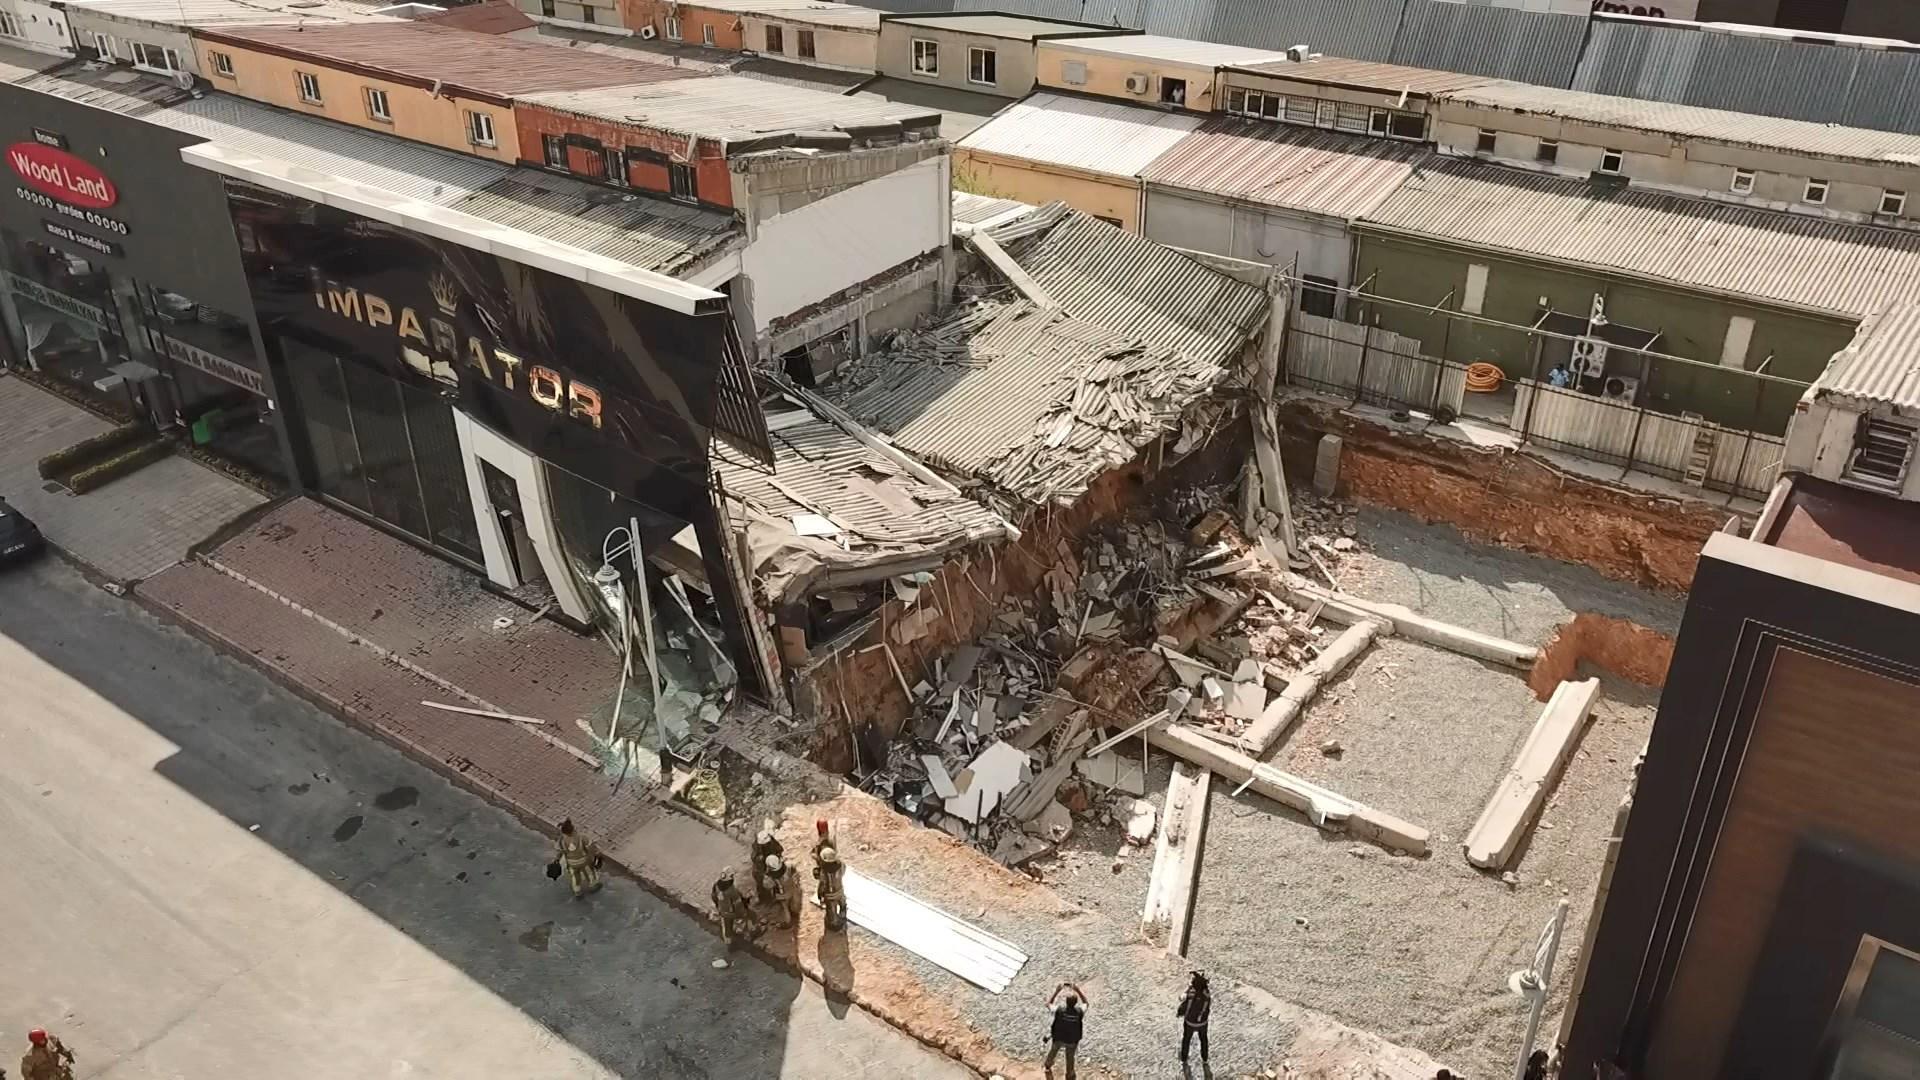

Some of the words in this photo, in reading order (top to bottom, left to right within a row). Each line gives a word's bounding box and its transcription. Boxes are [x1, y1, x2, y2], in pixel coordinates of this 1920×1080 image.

[35, 130, 59, 147] home
[11, 150, 63, 188] Wood
[63, 167, 109, 202] Land
